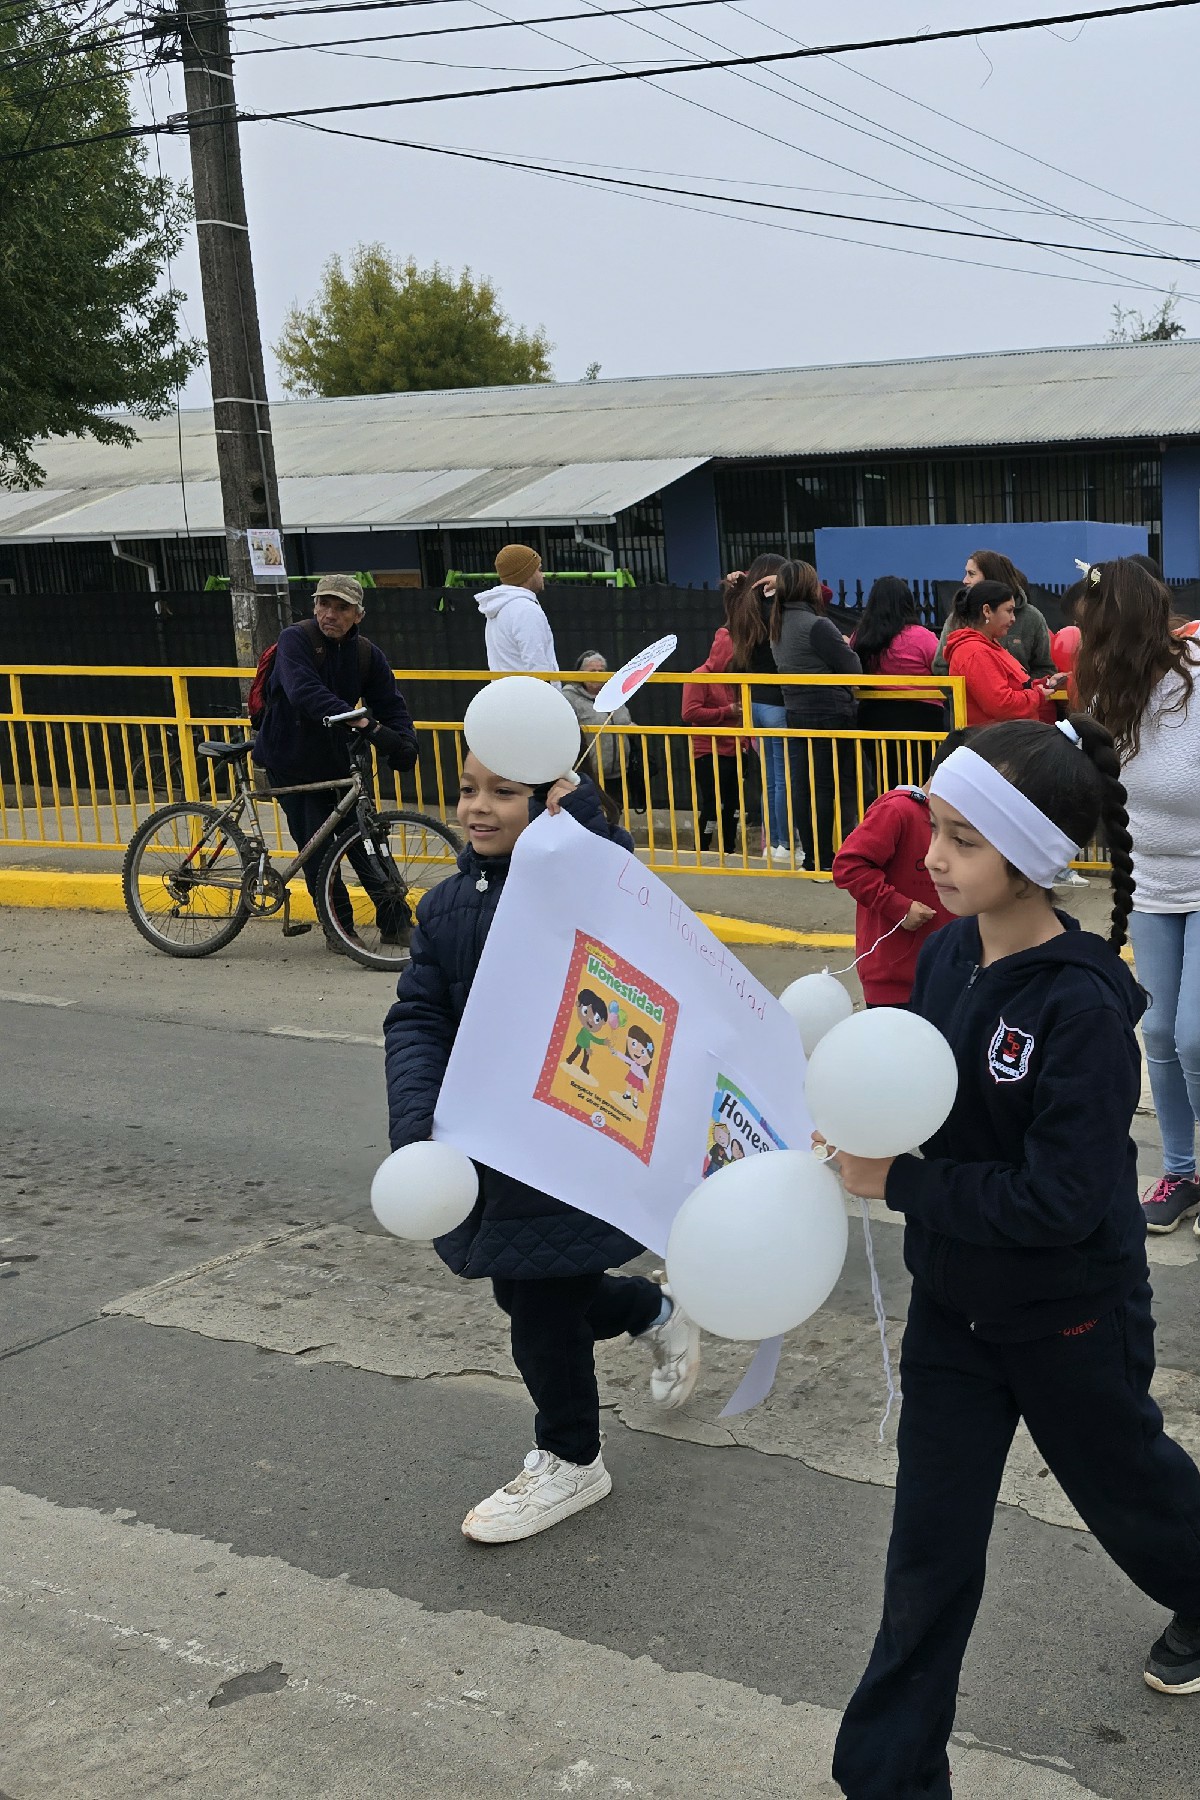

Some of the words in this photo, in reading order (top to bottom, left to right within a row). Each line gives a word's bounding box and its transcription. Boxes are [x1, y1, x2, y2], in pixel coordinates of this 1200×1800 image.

[587, 956, 664, 1024] Honestidad
[617, 858, 650, 907] La
[669, 895, 768, 1022] Honestidad
